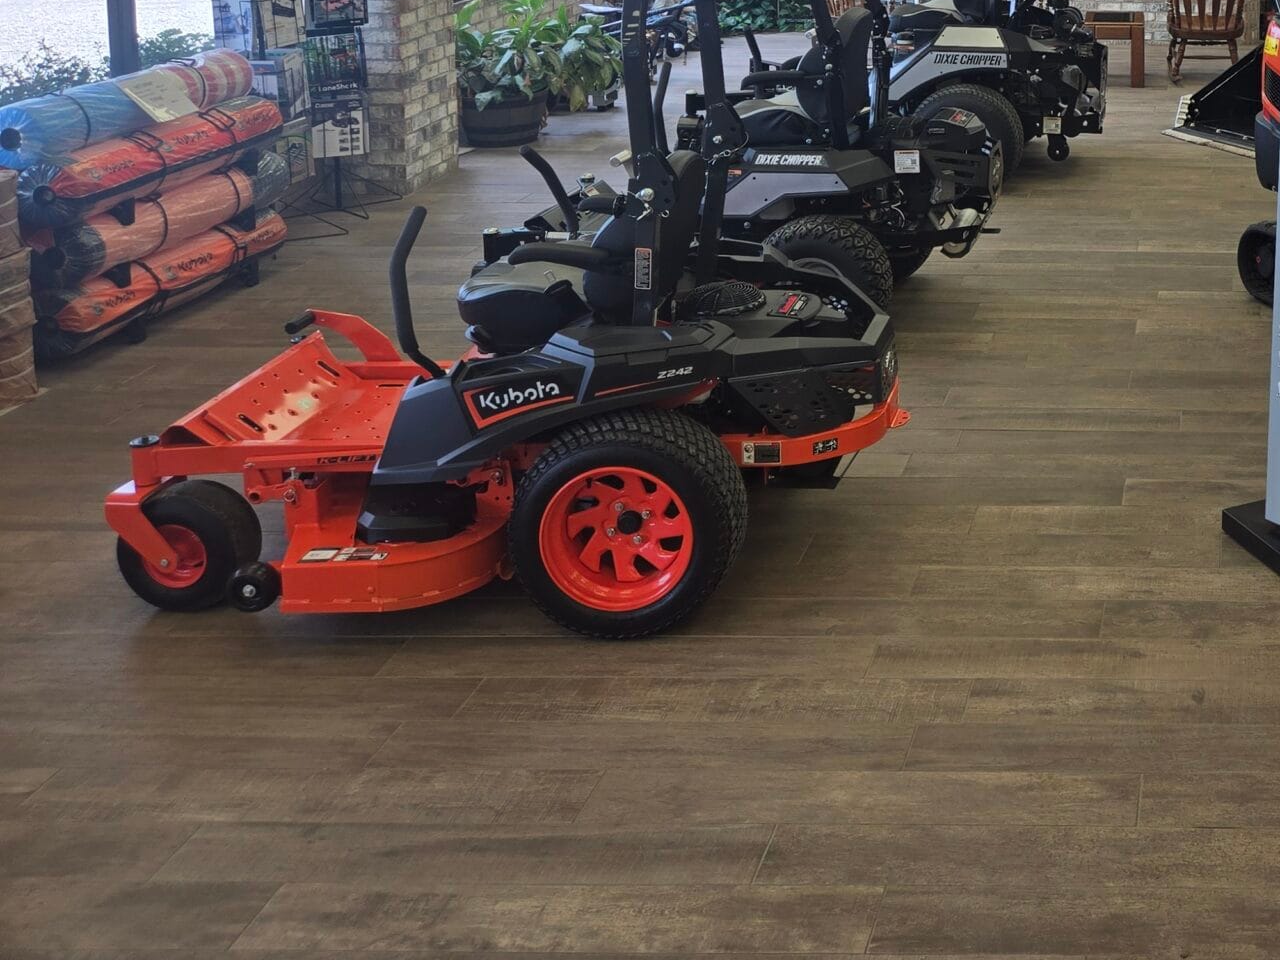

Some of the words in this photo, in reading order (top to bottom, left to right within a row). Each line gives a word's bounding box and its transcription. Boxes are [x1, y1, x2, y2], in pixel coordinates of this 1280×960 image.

[933, 53, 959, 65] DIXIE
[960, 54, 1002, 66] CHOPPER
[754, 154, 779, 165] DIXIE
[779, 154, 823, 167] CHOPPER
[177, 252, 213, 272] Kubota
[479, 381, 561, 410] Kubota
[657, 366, 694, 380] Z242
